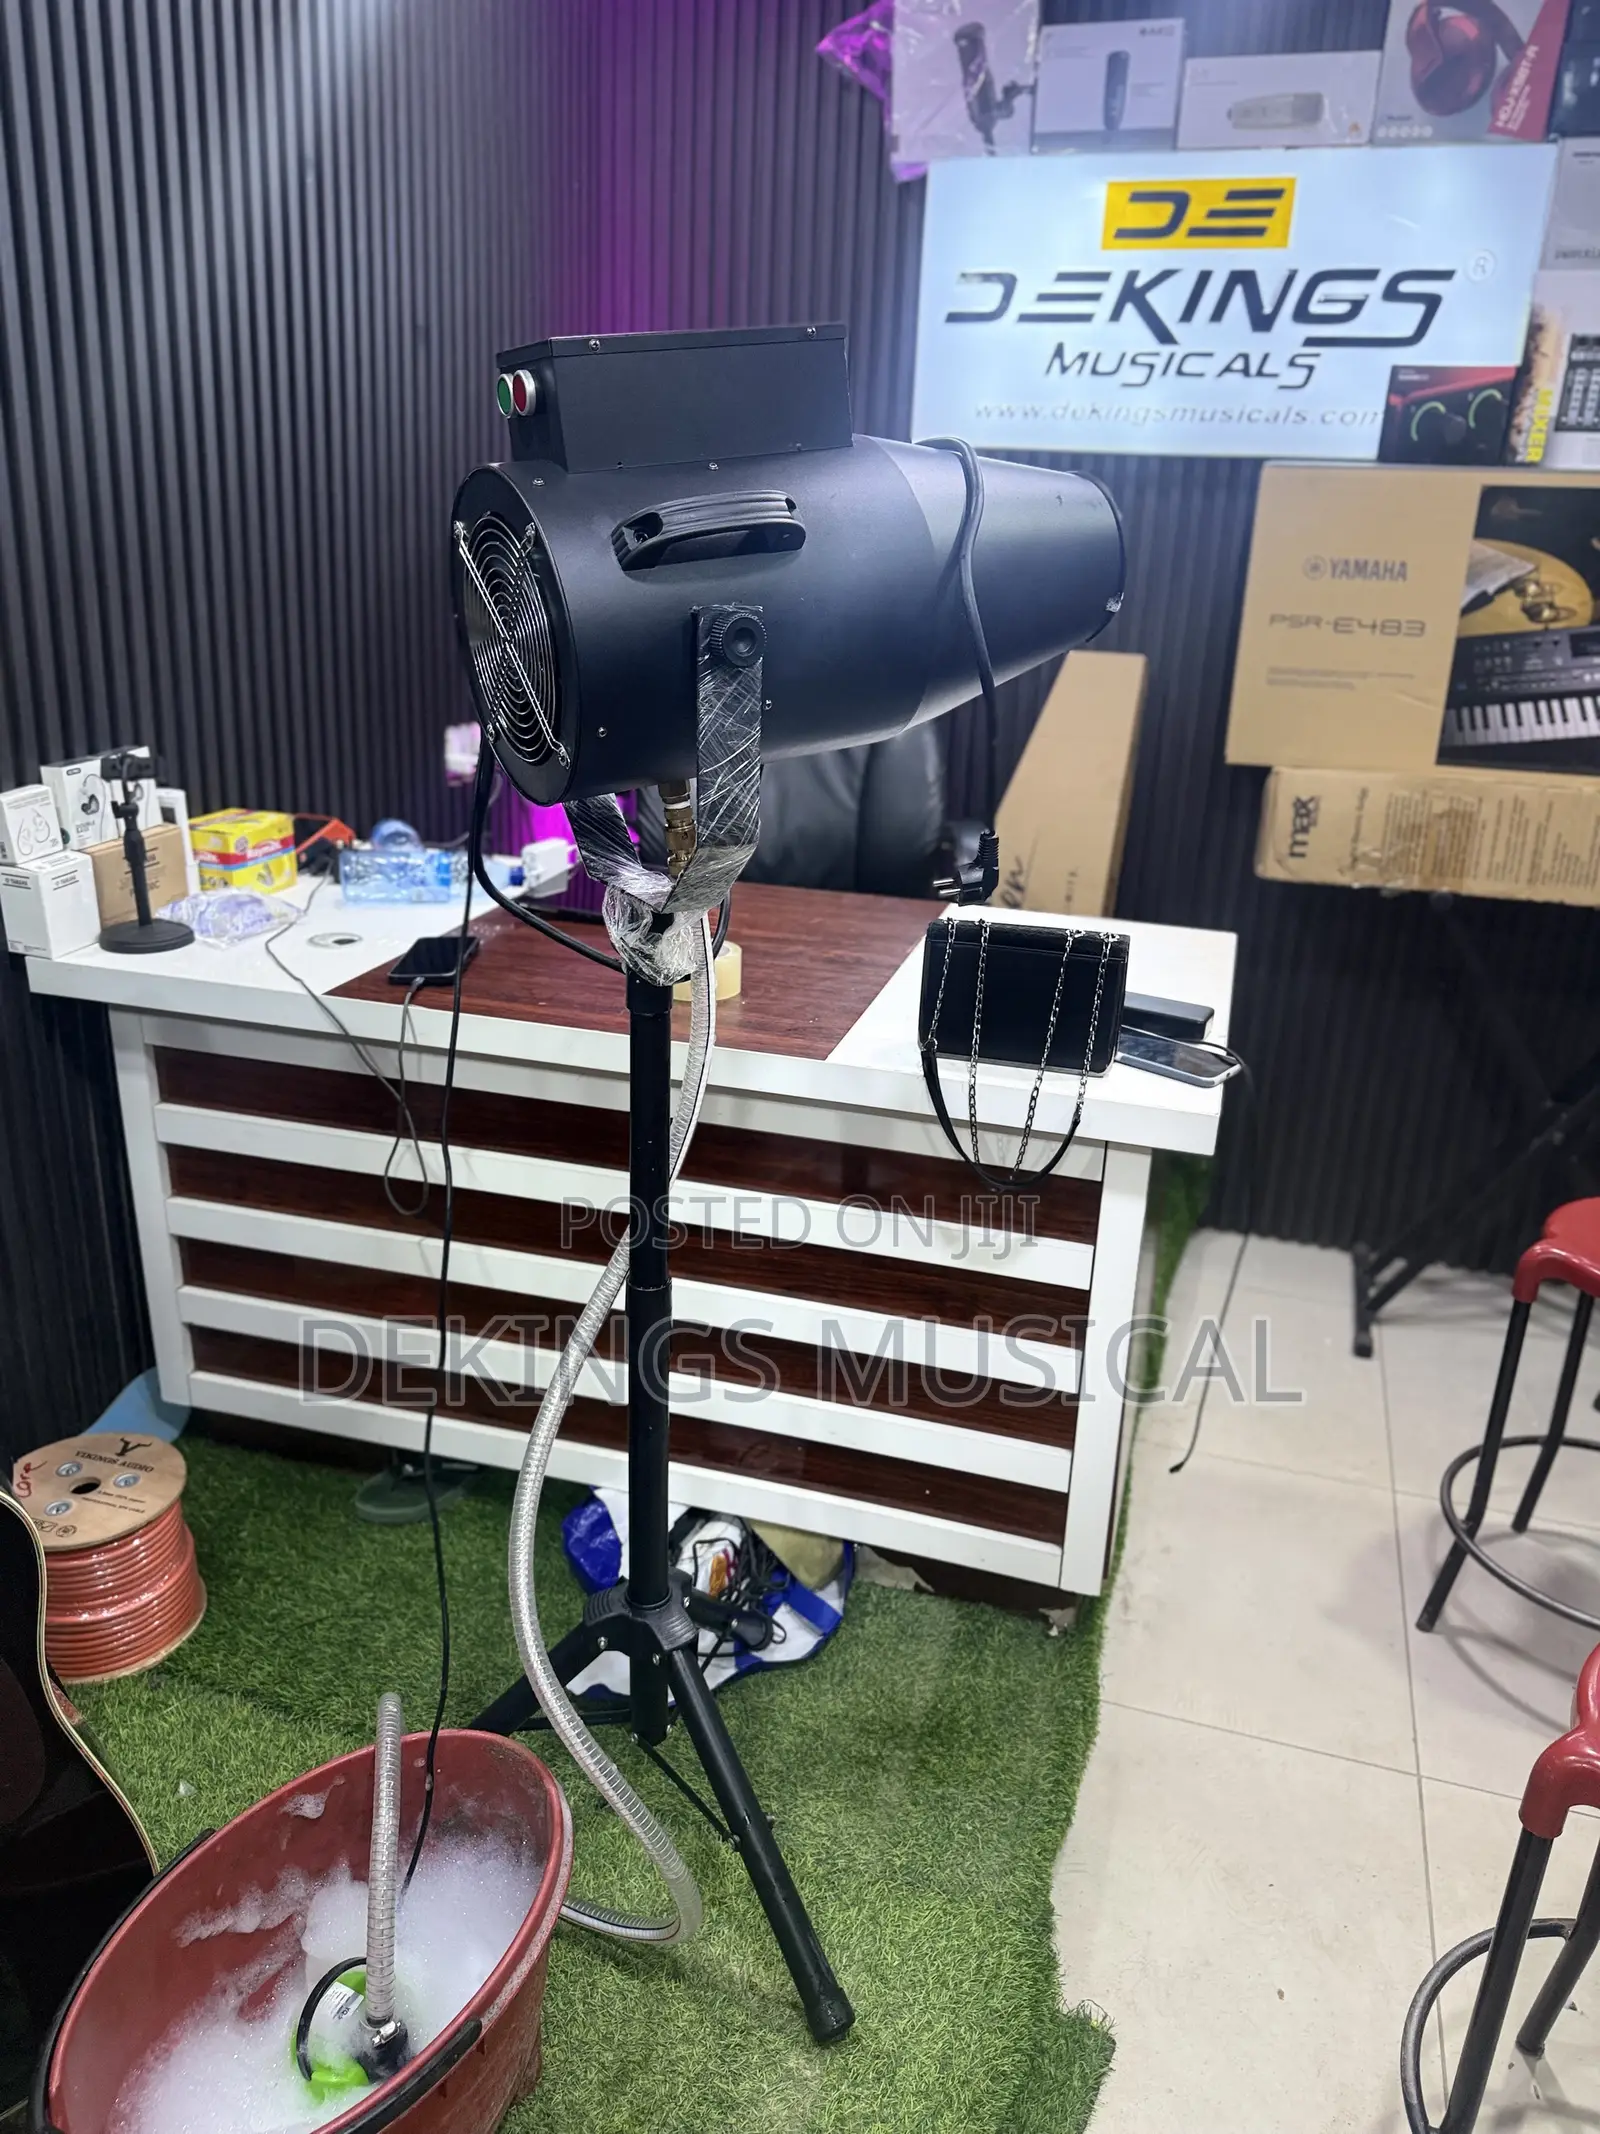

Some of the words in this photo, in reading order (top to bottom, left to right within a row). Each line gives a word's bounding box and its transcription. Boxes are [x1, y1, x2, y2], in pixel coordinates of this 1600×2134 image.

[1113, 188, 1286, 239] DE
[945, 268, 1456, 347] DEKINGS
[1045, 341, 1321, 389] MUSICALS
[1329, 558, 1408, 582] YAMAHA
[1269, 613, 1426, 638] PSR-E483
[74, 1450, 119, 1466] VIKINGS
[117, 1459, 155, 1474] AUDIO
